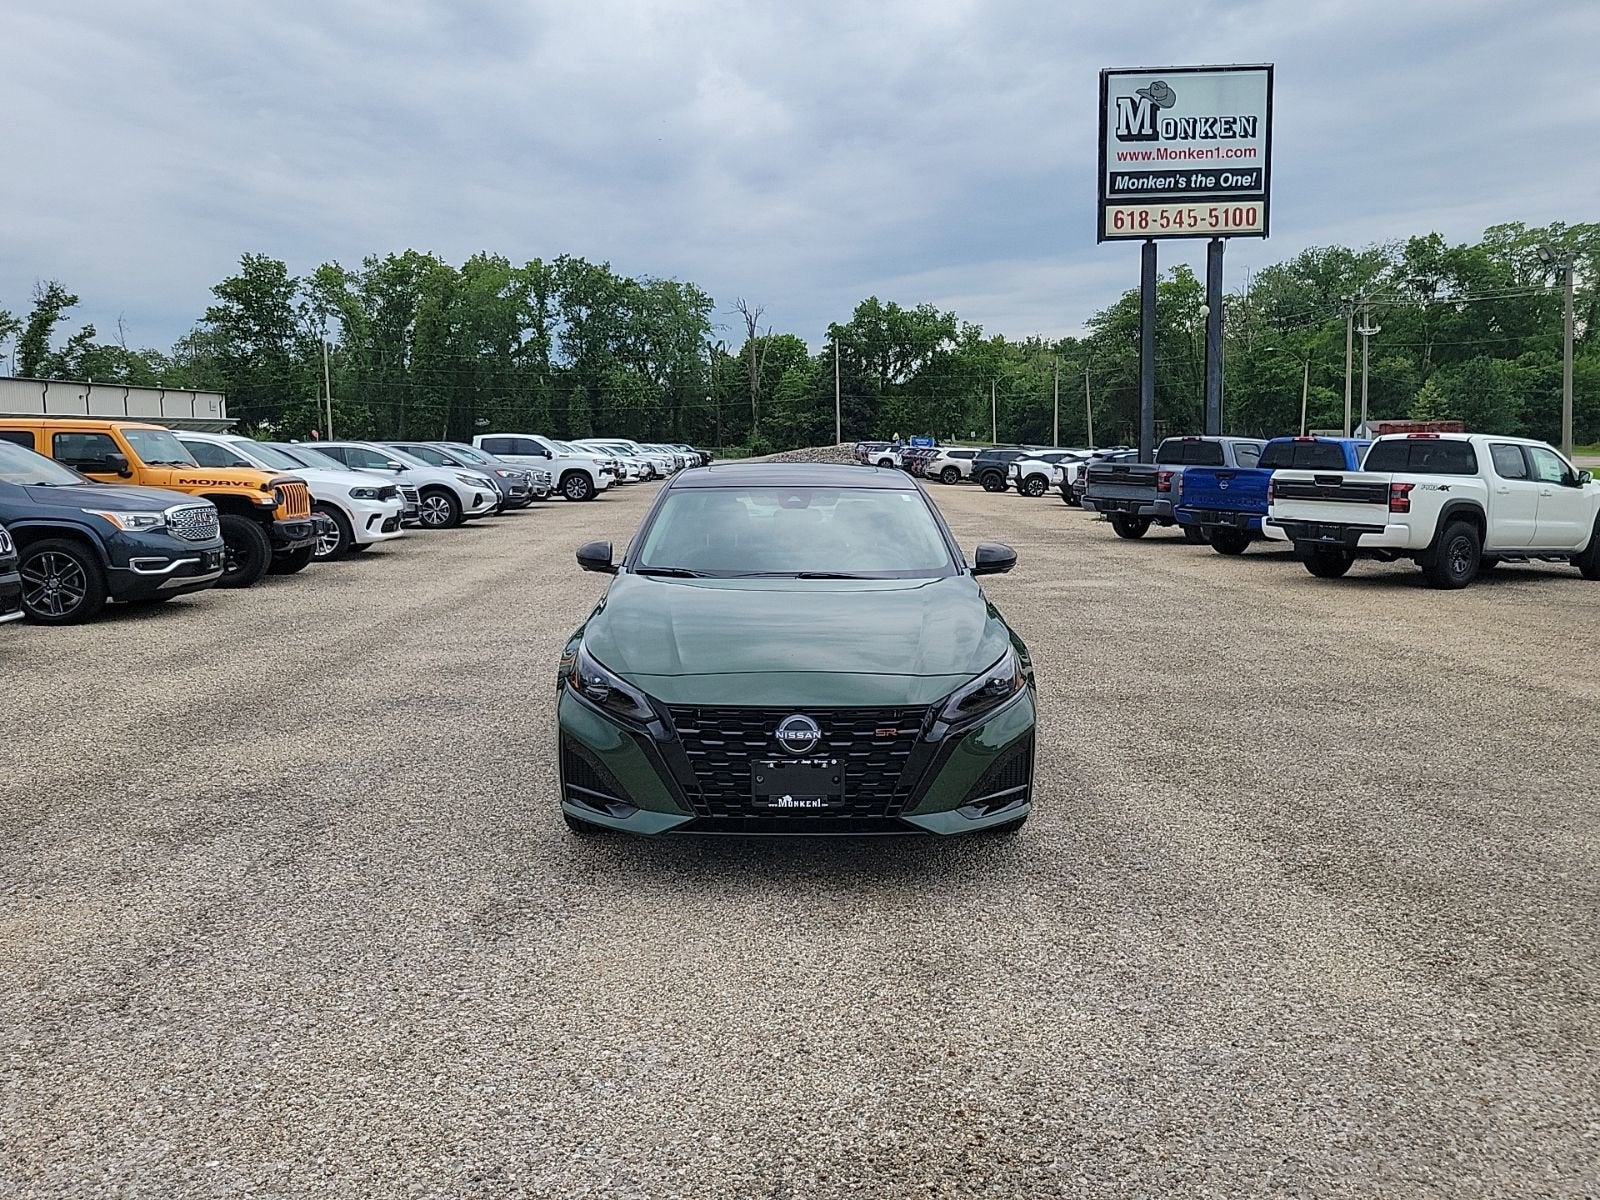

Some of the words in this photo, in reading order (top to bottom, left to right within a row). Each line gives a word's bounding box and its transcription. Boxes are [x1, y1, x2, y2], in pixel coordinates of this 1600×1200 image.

[1116, 97, 1258, 141] MONKEN
[1117, 147, 1257, 161] www.Monken1.com
[1115, 174, 1187, 190] Monken's
[1191, 173, 1215, 188] the
[1220, 172, 1257, 187] One!
[1113, 207, 1257, 230] 618-545-5100
[178, 478, 256, 487] MOJAVE
[776, 730, 821, 739] NISSAN
[875, 728, 897, 736] SR
